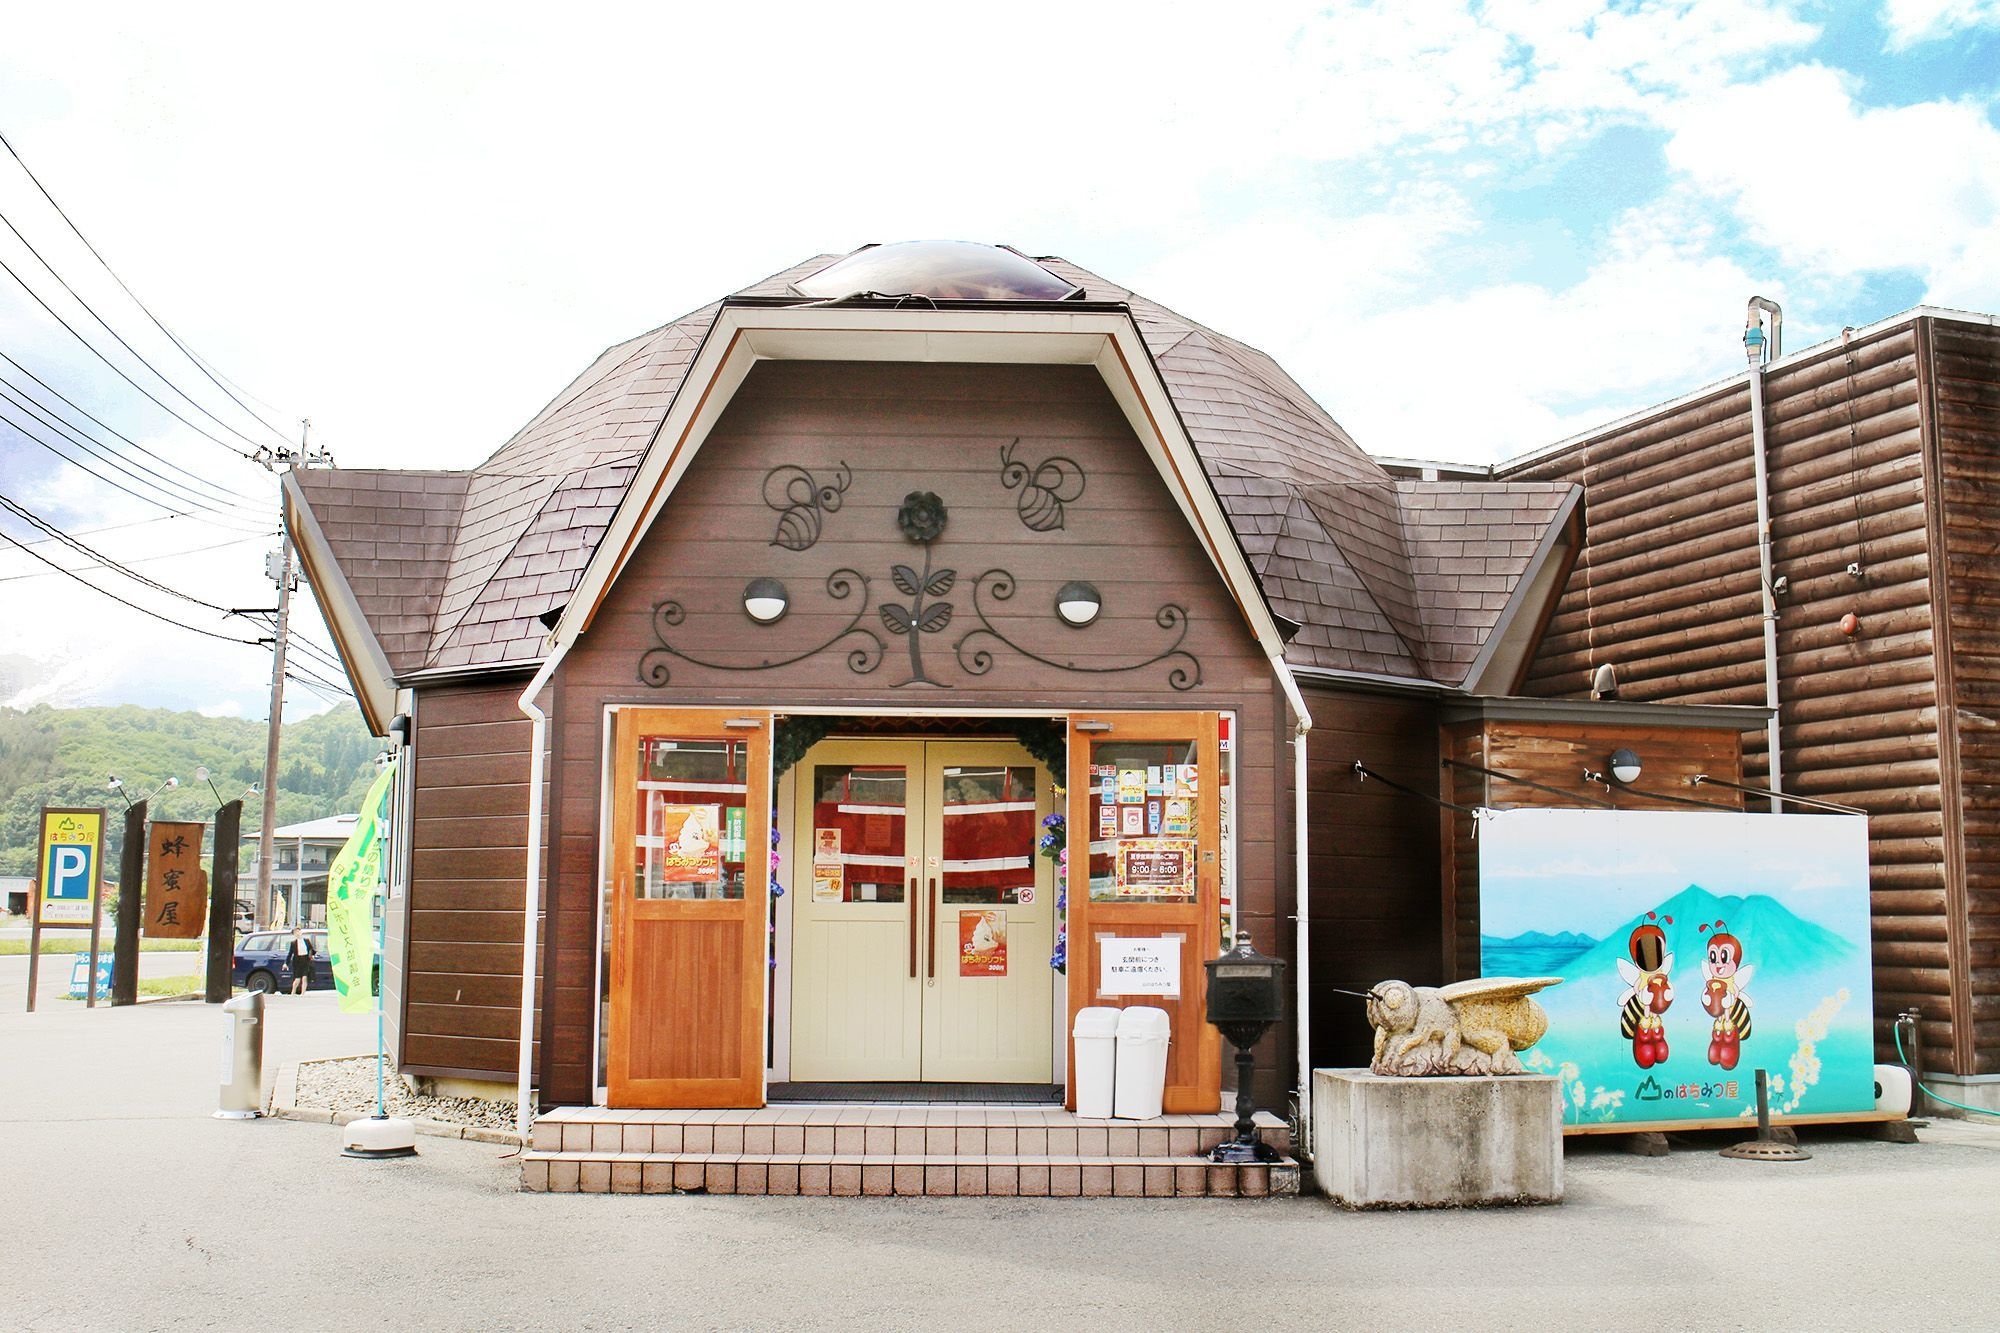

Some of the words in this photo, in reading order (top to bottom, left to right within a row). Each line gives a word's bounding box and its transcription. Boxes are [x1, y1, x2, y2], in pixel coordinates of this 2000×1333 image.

[53, 847, 87, 897] P
[665, 857, 717, 867] はちみつソフト
[156, 835, 190, 926] 蜂蜜屋
[961, 955, 1005, 964] はちみつソフト
[1634, 1075, 1738, 1101] 山のはちみつ屋
